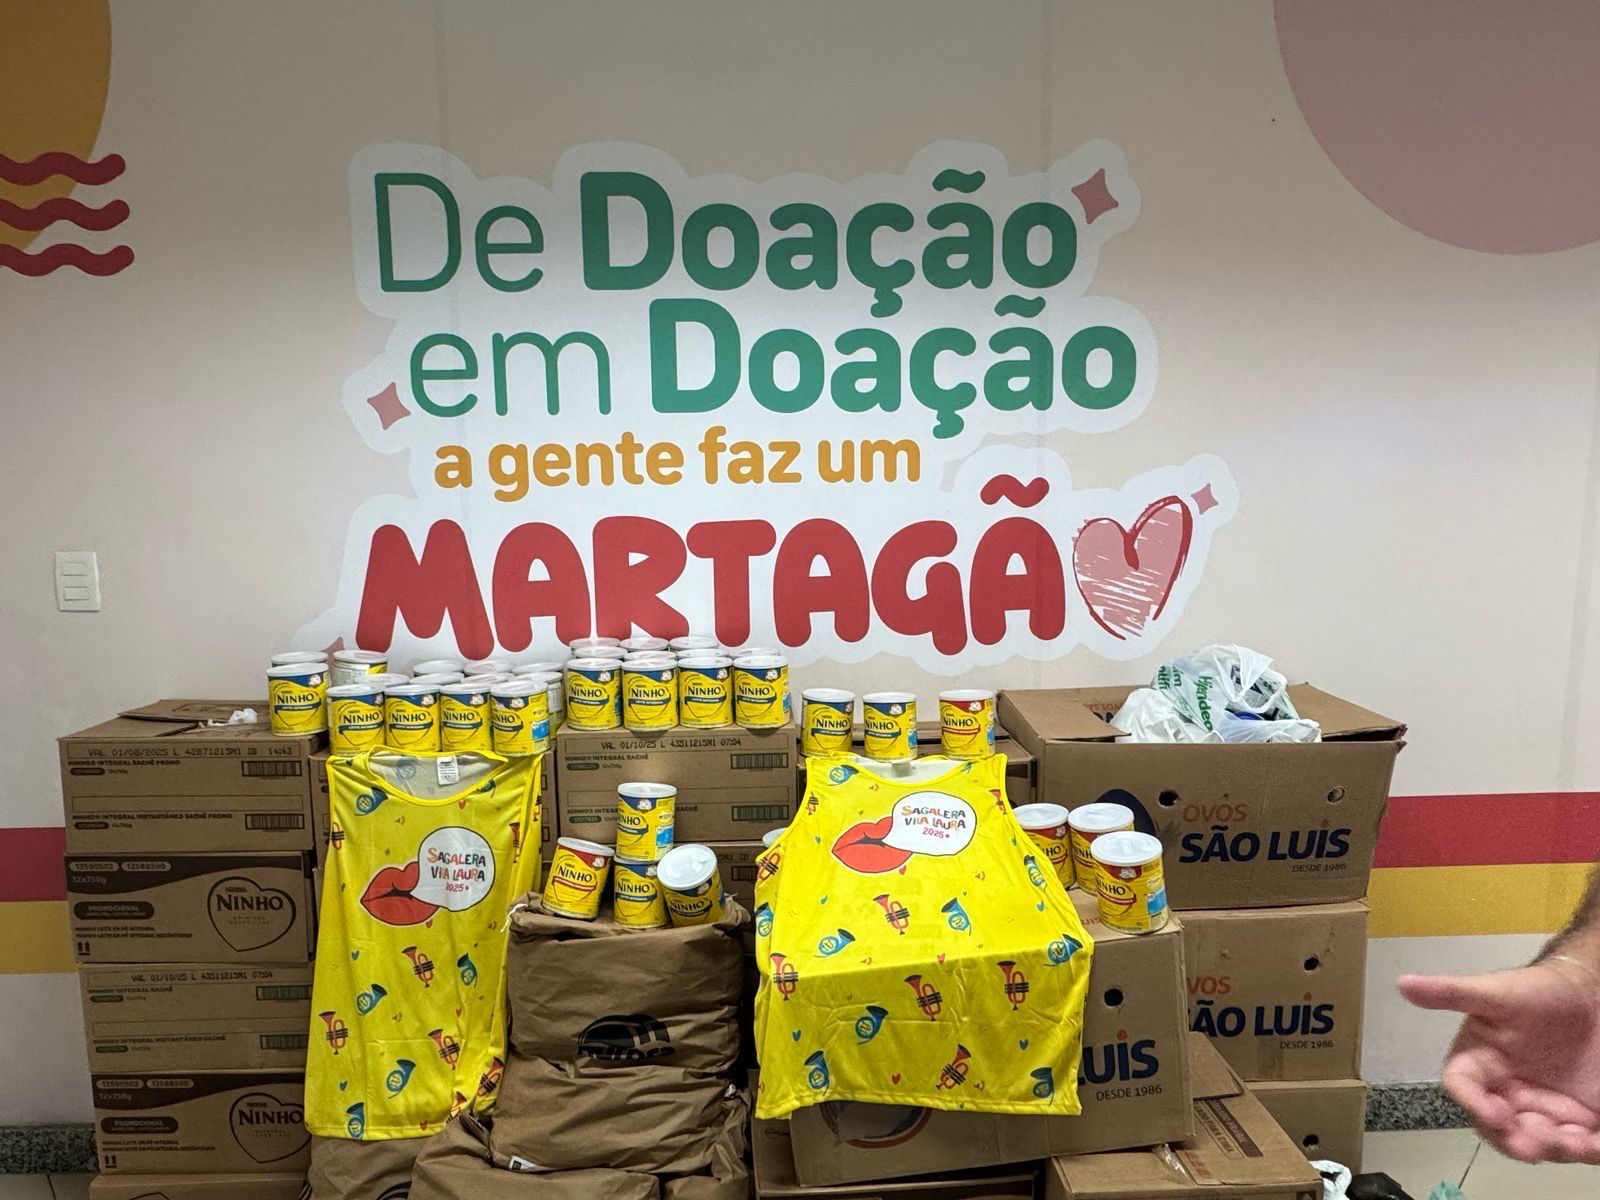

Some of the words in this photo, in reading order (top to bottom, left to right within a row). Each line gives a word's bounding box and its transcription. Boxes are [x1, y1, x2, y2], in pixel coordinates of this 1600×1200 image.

[374, 172, 544, 292] De
[581, 168, 1077, 317] Doação
[409, 331, 612, 417] em
[649, 296, 1137, 438] Doação
[434, 444, 473, 488] a
[488, 431, 684, 502] gente
[698, 426, 802, 484] faz
[818, 439, 920, 483] um
[356, 475, 1066, 660] MARTAGÃ
[570, 686, 603, 698] NINHO
[631, 687, 666, 698] NINHO
[687, 686, 722, 696] NINHO
[737, 686, 771, 697] NINHO
[277, 692, 315, 704] NINHO
[342, 712, 380, 724] NINHO
[391, 711, 427, 723] NINHO
[443, 711, 475, 722] NINHO
[942, 716, 973, 727] NINHO
[816, 718, 848, 729] NINHO
[601, 741, 616, 750] VAL
[88, 748, 105, 756] VAL
[1181, 803, 1248, 824] OVOS
[932, 818, 966, 831] LAURA
[922, 827, 944, 839] 2025
[1178, 824, 1261, 864] SÃO
[427, 847, 486, 867] SAGALERA
[1292, 863, 1321, 873] DESDE
[1323, 862, 1347, 872] 1986
[453, 868, 485, 882] LAURA
[558, 865, 593, 883] NINHO
[617, 882, 650, 894] NINHO
[216, 893, 284, 911] NINHO
[671, 899, 705, 911] NINHO
[1187, 976, 1231, 995] VOS
[1189, 999, 1246, 1038] ÃO
[1280, 1040, 1309, 1050] DESDE
[1310, 1040, 1334, 1049] 1986
[1096, 1088, 1132, 1101] DESDE
[1134, 1084, 1162, 1098] 1986
[239, 1110, 304, 1126] NINHO
